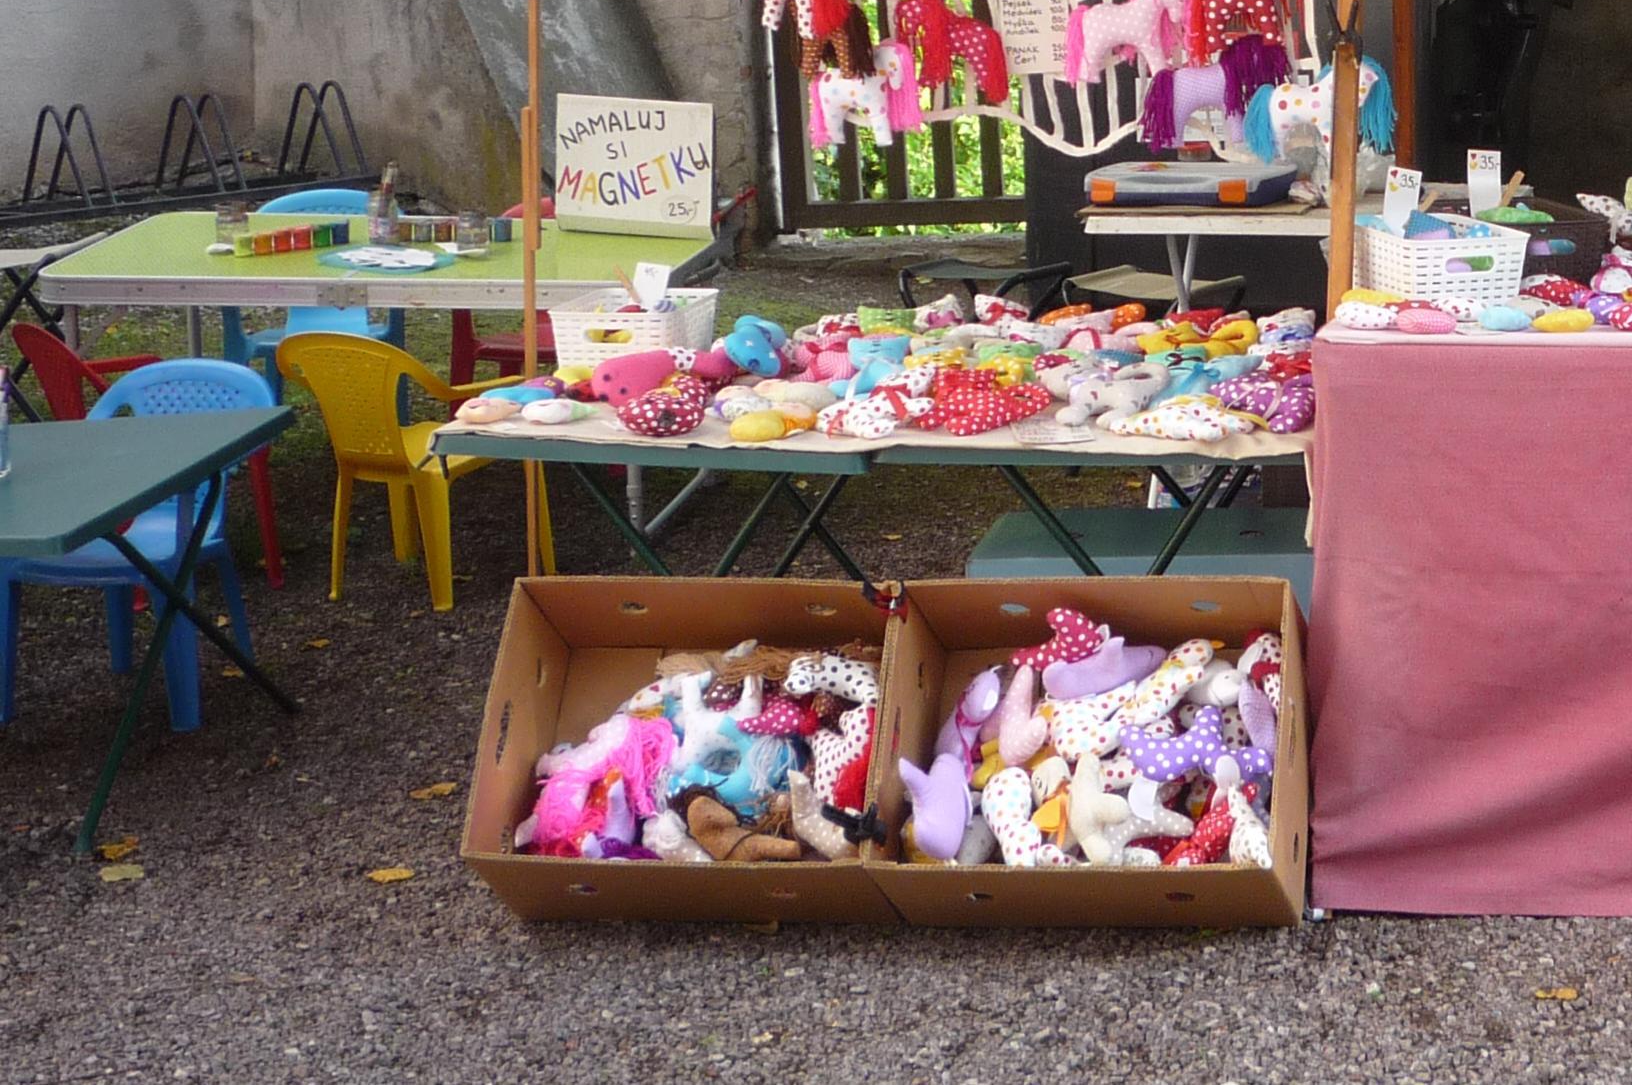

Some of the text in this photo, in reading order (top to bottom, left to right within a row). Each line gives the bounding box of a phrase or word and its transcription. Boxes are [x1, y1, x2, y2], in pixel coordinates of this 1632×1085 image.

[559, 110, 666, 150] NAMALUJ
[606, 140, 628, 160] SI
[1479, 155, 1500, 171] 35,-
[556, 142, 711, 206] MAGNETKU
[1400, 174, 1419, 190] 35,-
